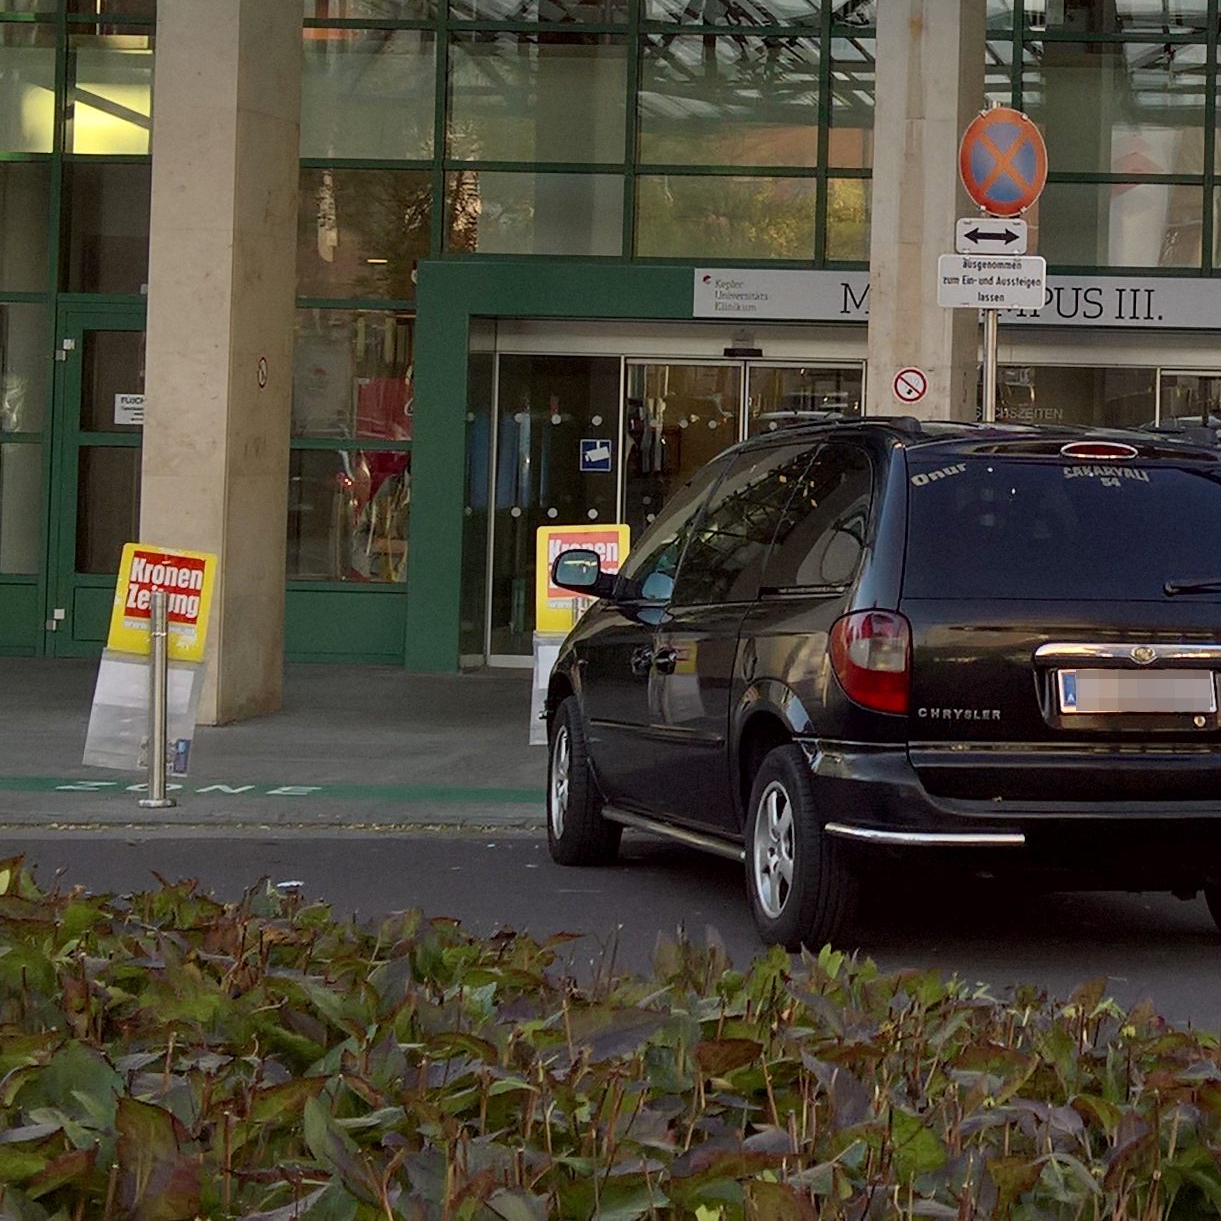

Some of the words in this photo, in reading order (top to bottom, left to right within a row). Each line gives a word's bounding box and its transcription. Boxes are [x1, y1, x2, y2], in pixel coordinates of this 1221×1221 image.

[714, 280, 744, 290] Kepler
[943, 277, 959, 285] zum
[996, 277, 1041, 288] Aussteigen
[978, 292, 1005, 301] lassen
[1114, 288, 1163, 321] III.
[911, 463, 967, 487] Onur
[130, 557, 204, 590] Kronen
[127, 583, 200, 618] Zeung
[918, 707, 1001, 720] CHRYSLER
[56, 782, 322, 796] ZONE
